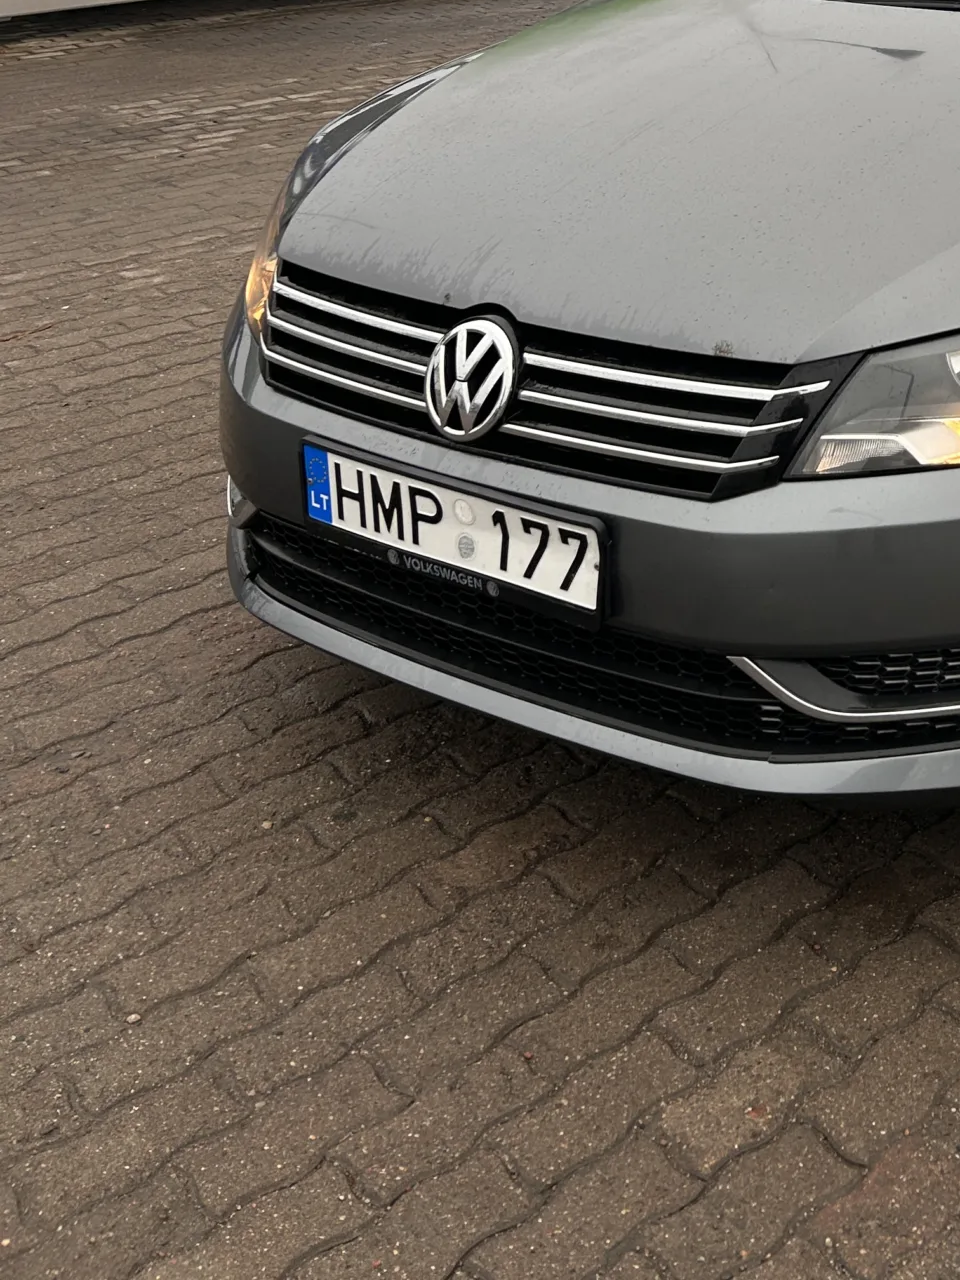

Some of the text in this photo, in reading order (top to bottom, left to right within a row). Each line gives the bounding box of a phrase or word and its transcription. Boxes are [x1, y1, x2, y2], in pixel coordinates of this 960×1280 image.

[311, 489, 330, 512] LT
[333, 461, 589, 592] HMP 177
[403, 554, 483, 591] VOLKSWAGEN
